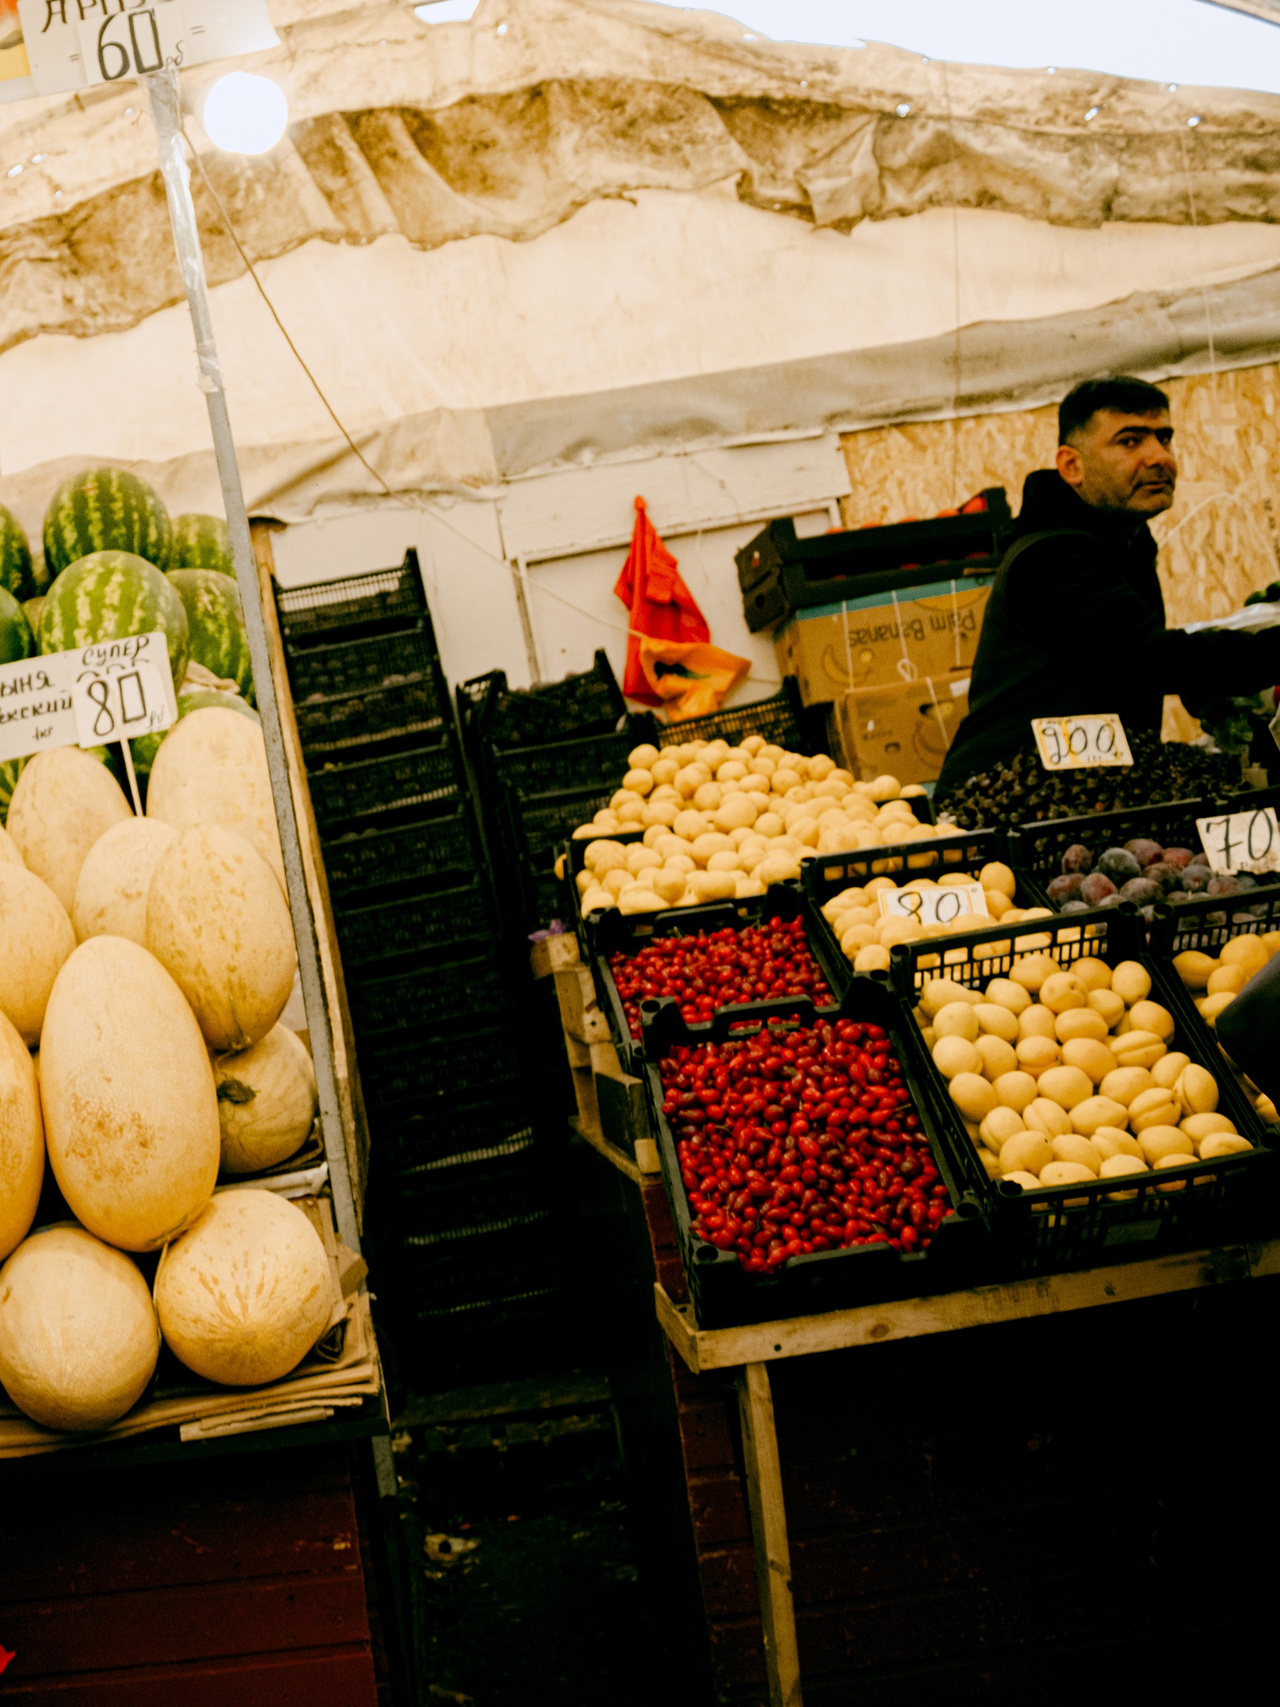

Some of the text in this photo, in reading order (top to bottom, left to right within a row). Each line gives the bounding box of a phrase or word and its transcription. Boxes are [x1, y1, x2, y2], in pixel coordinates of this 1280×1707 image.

[98, 8, 163, 81] 60
[87, 670, 147, 737] 80
[1205, 809, 1273, 870] 70
